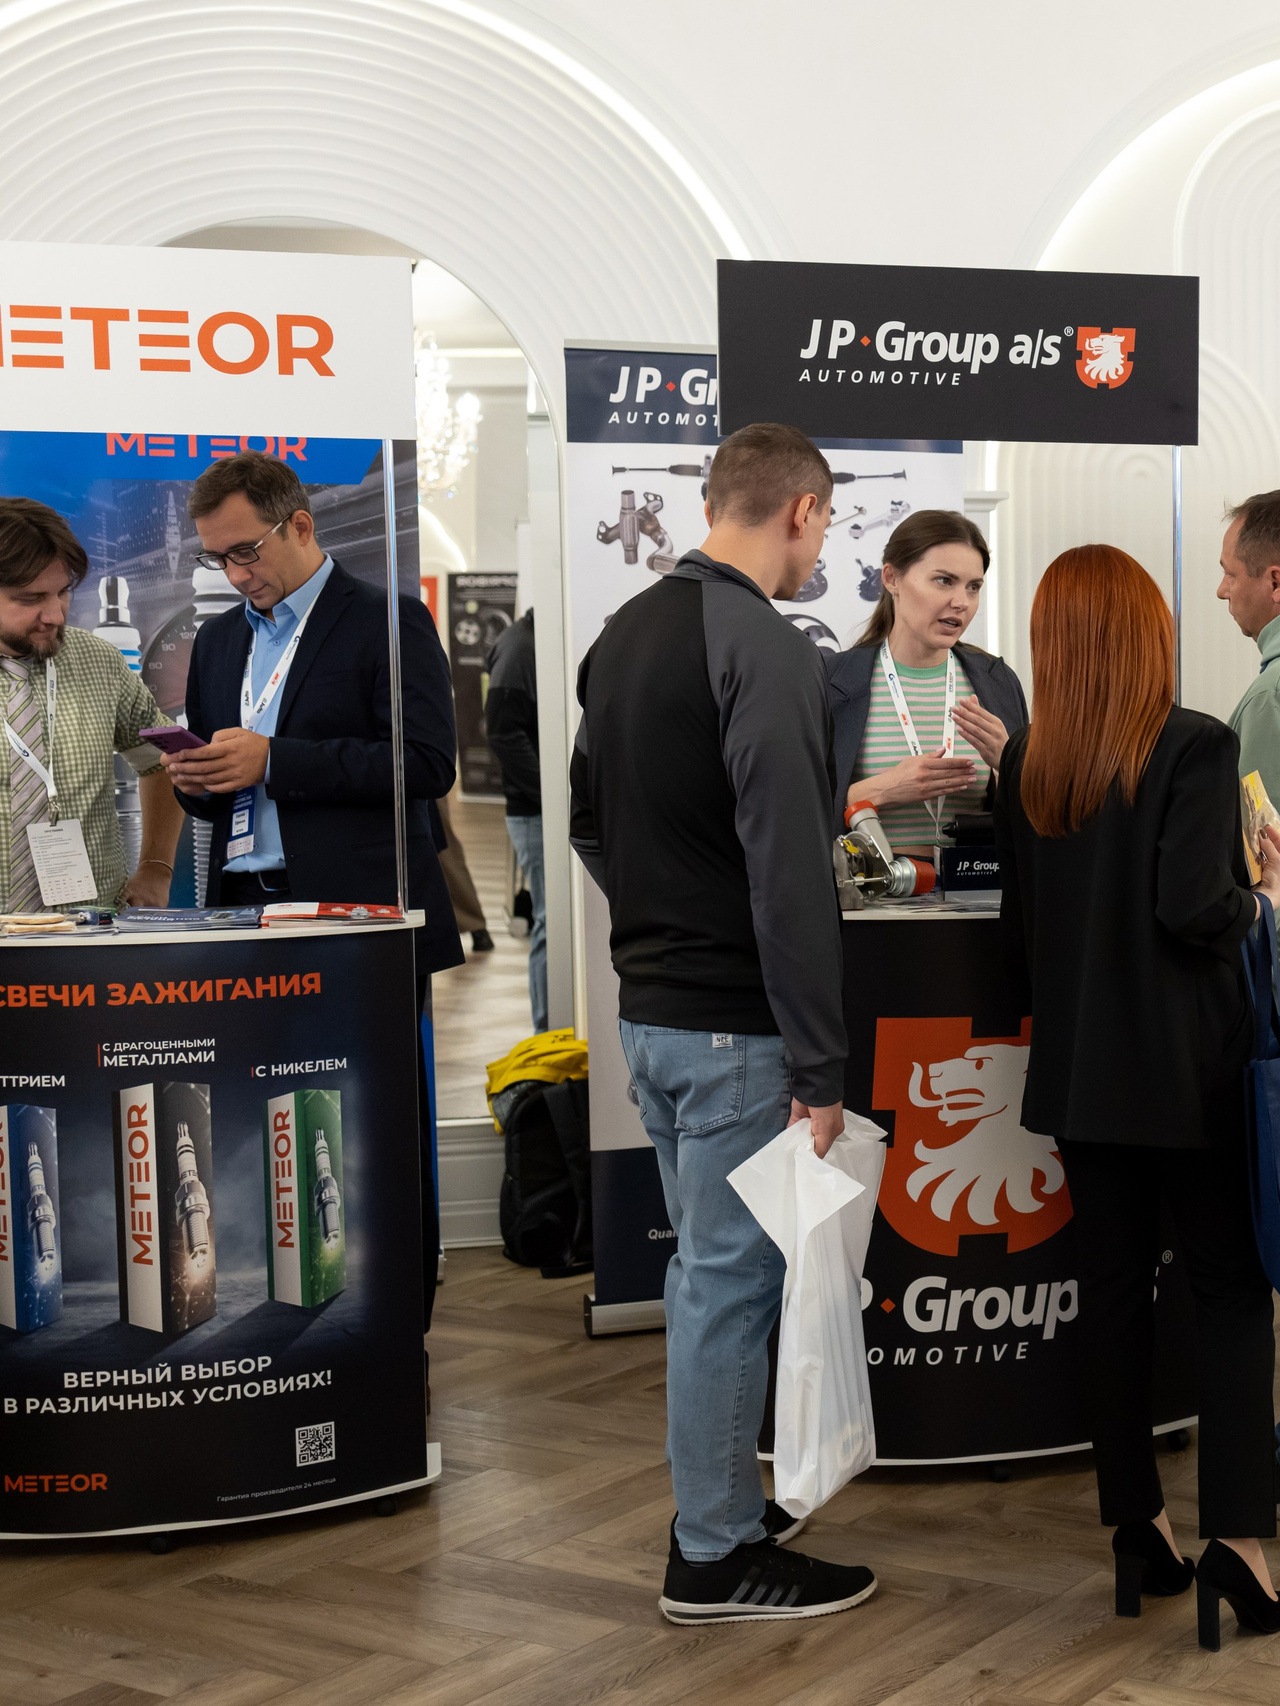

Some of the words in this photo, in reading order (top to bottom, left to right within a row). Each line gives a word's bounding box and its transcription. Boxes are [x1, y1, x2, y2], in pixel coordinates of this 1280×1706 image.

[0, 304, 336, 377] ETEOR
[799, 369, 961, 386] AUTOMOTIVE
[107, 972, 321, 1006] ЗАЖИГАНИЯ
[102, 1043, 110, 1052] С
[113, 1038, 216, 1052] ДРАГОЦЕННЫМИ
[103, 1050, 215, 1067] МЕТАЛЛАМИ
[255, 1065, 266, 1078] С
[271, 1057, 348, 1076] НИКЕЛЕМ
[127, 1103, 154, 1266] METEOR
[273, 1109, 295, 1248] METEOR
[903, 1276, 1078, 1340] Group
[867, 1342, 1029, 1366] OMOTIVE
[64, 1363, 171, 1388] ВЕРНЫЙ
[181, 1355, 272, 1380] ВЫБОР
[4, 1398, 18, 1414] В
[26, 1390, 185, 1414] РАЗЛИЧНЫХ
[192, 1369, 332, 1405] УСЛОВИЯХ!
[4, 1473, 108, 1493] METEOR
[217, 1493, 249, 1502] Гарантия
[251, 1483, 302, 1499] производителя
[304, 1481, 312, 1489] 24
[313, 1477, 336, 1487] месяца
